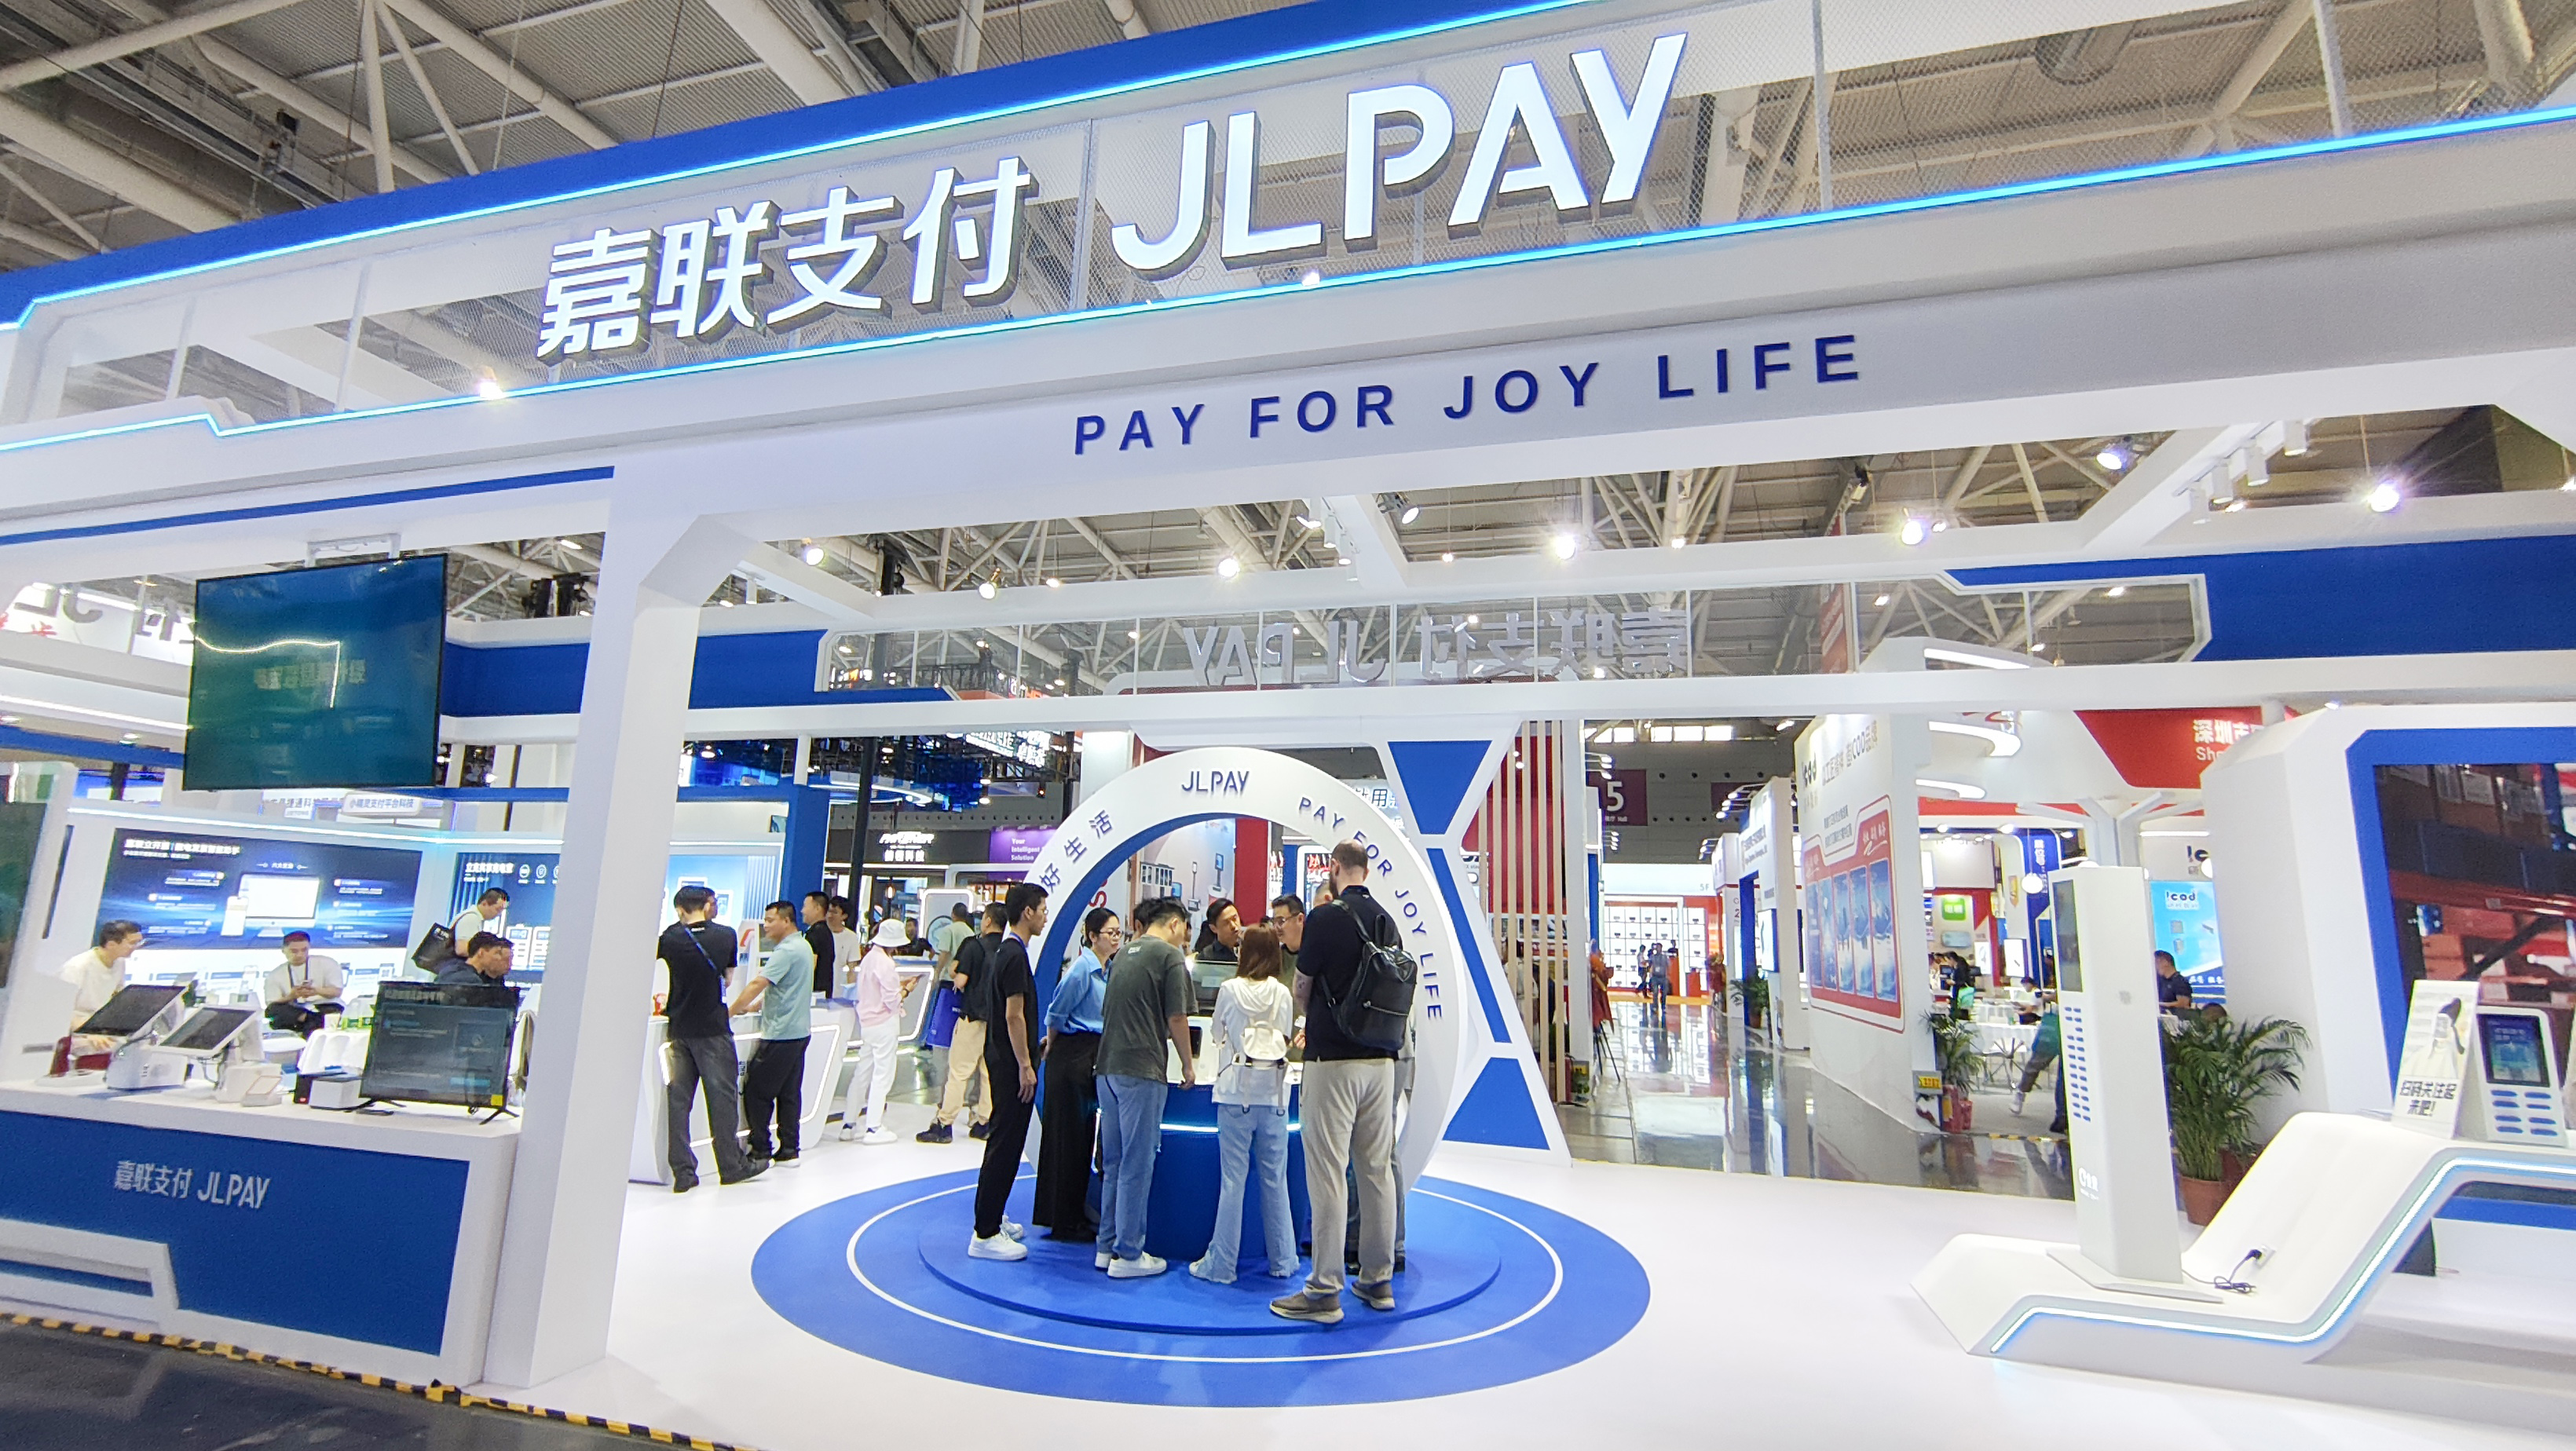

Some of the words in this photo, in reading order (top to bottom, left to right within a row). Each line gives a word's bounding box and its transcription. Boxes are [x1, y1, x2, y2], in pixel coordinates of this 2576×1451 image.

[537, 156, 1034, 360] 嘉联支付
[1075, 404, 1204, 455] PAY
[1249, 384, 1394, 439] FOR
[1444, 361, 1600, 420] JOY
[1657, 334, 1860, 400] LIFE
[1180, 770, 1250, 793] JLPAY
[1606, 780, 1624, 812] 5
[1038, 809, 1114, 894] 好生活
[1298, 796, 1346, 829] PAY
[1352, 830, 1393, 878] FOR
[1395, 889, 1428, 936] JOY
[1419, 952, 1443, 1019] LIFE
[113, 1160, 194, 1200] 嘉联支付
[197, 1171, 271, 1209] JLPAY
